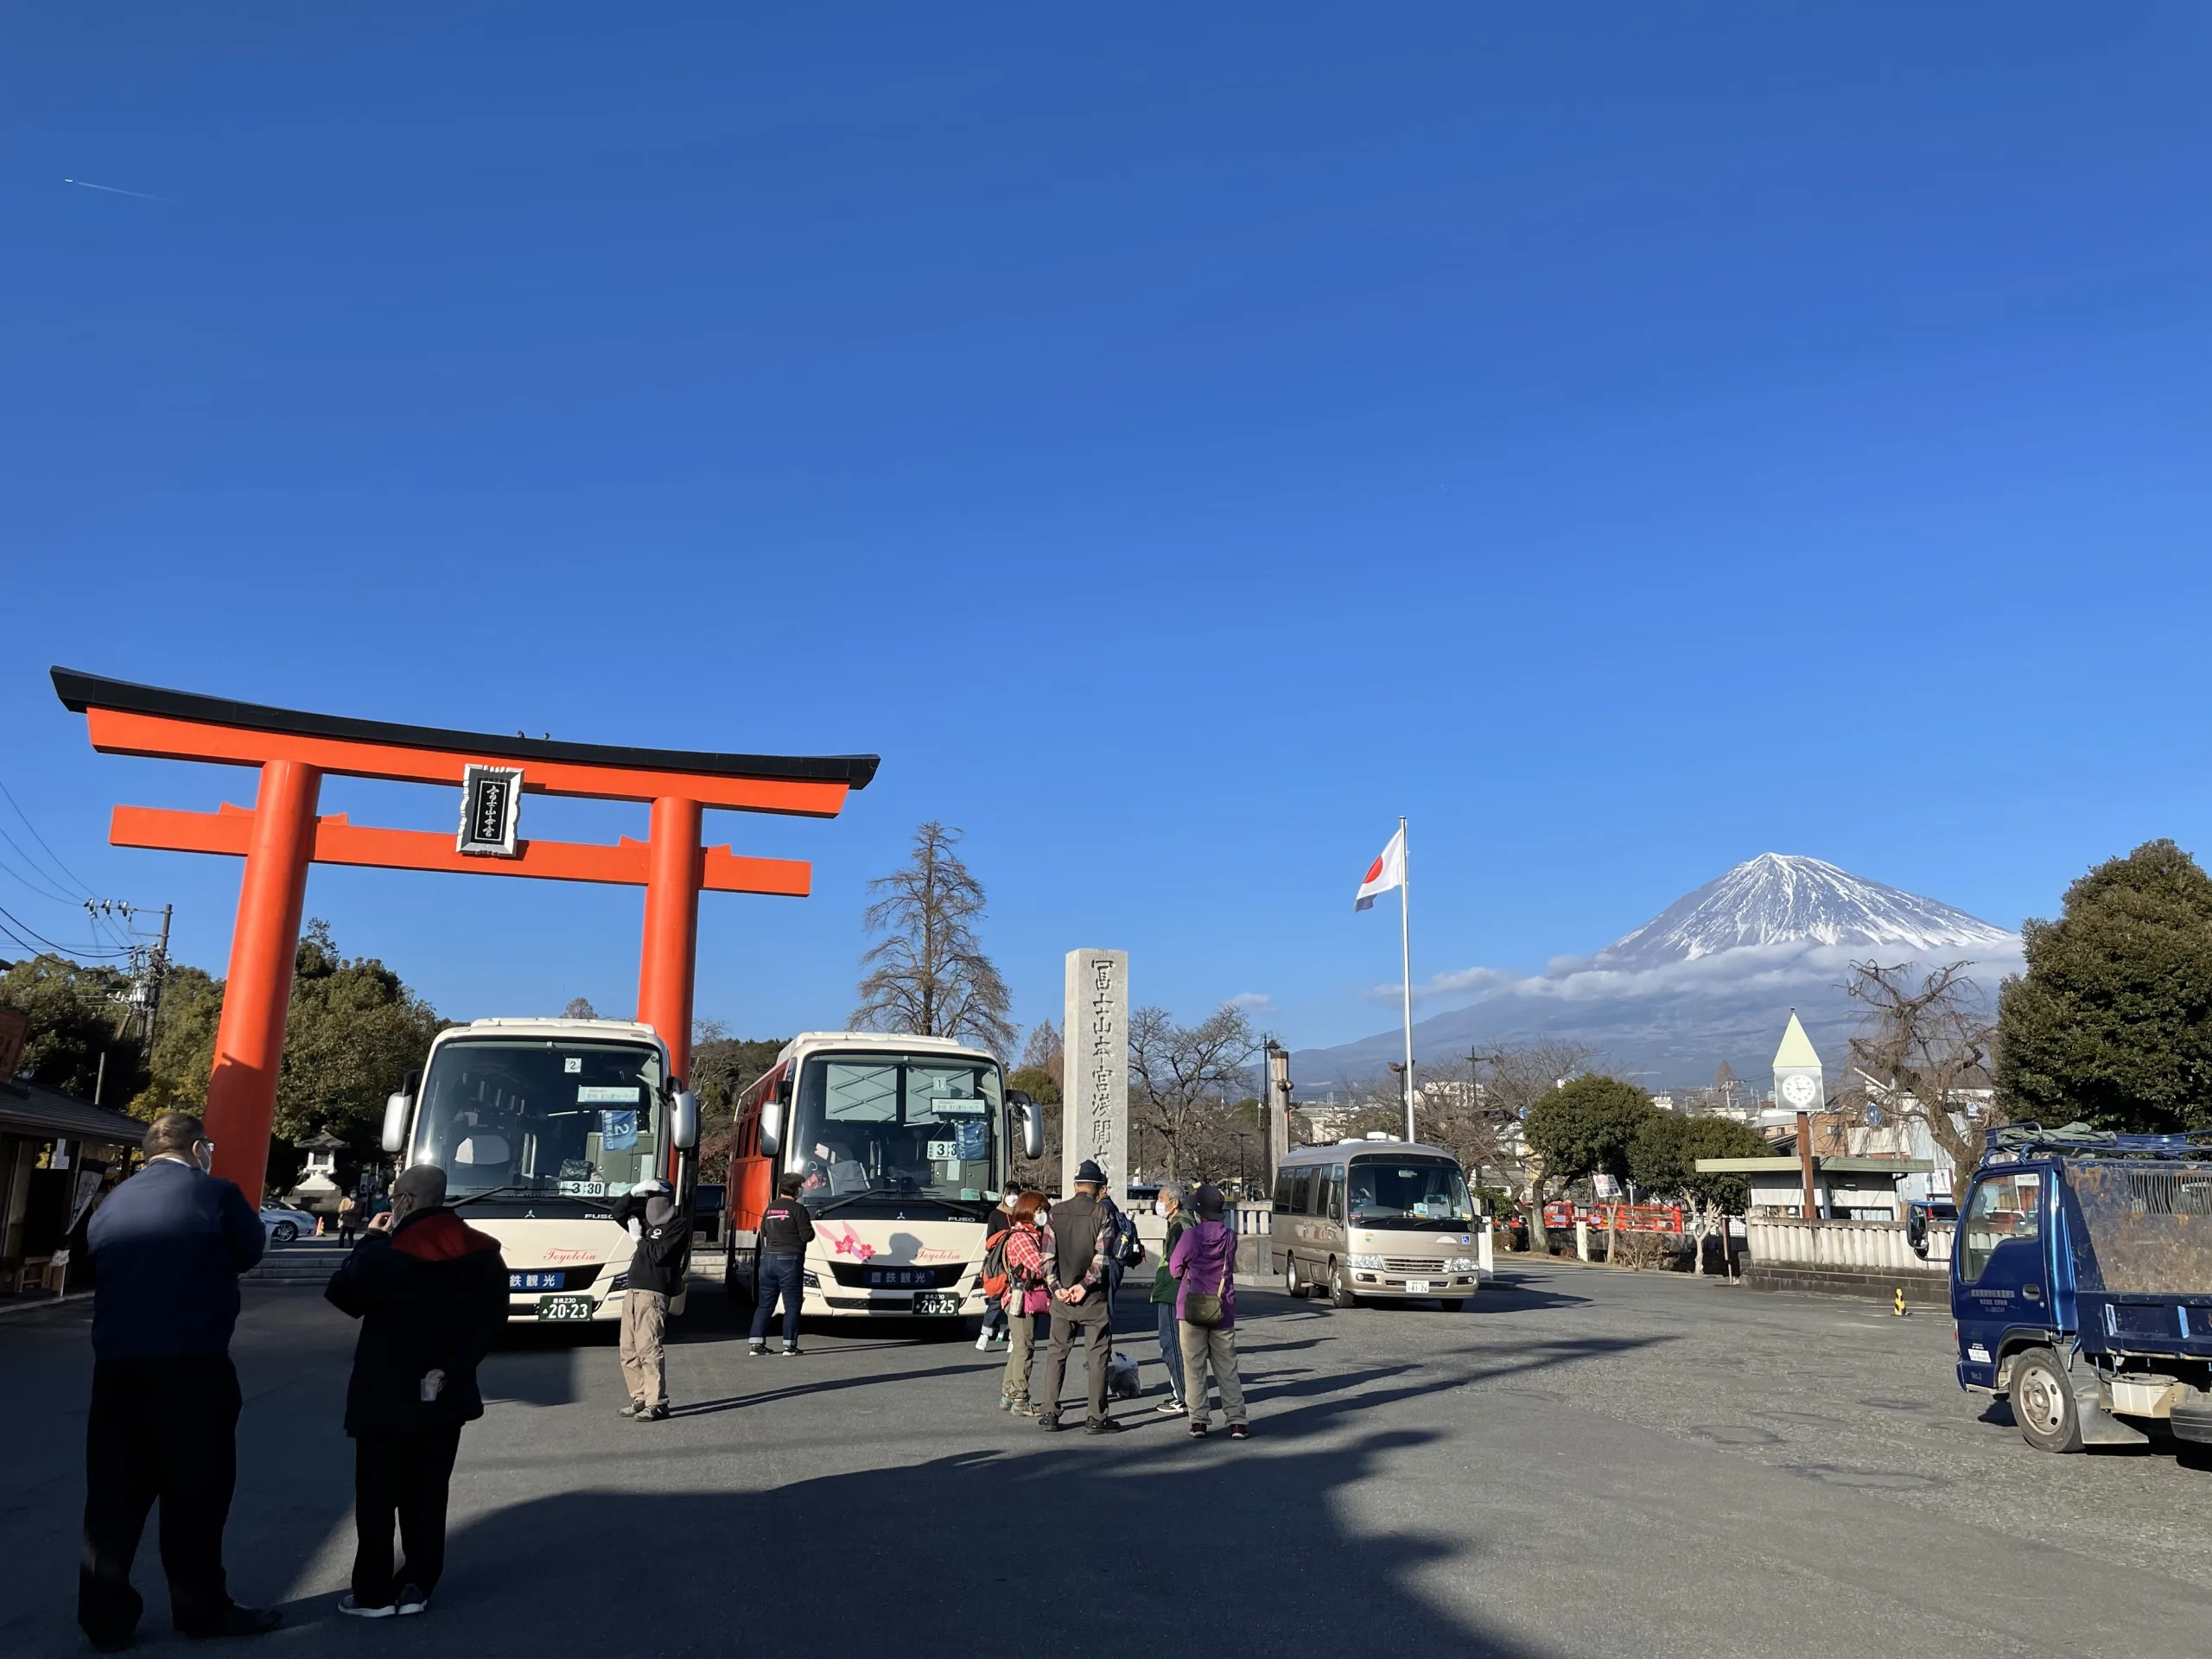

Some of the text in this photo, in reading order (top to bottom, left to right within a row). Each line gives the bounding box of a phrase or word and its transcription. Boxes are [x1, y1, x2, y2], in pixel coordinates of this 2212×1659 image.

[570, 1060, 576, 1070] 2
[614, 1123, 630, 1136] 2
[543, 1247, 598, 1263] Toyotetsu
[917, 1247, 961, 1262] Toyotetsu
[509, 1274, 556, 1287] 鉄観光
